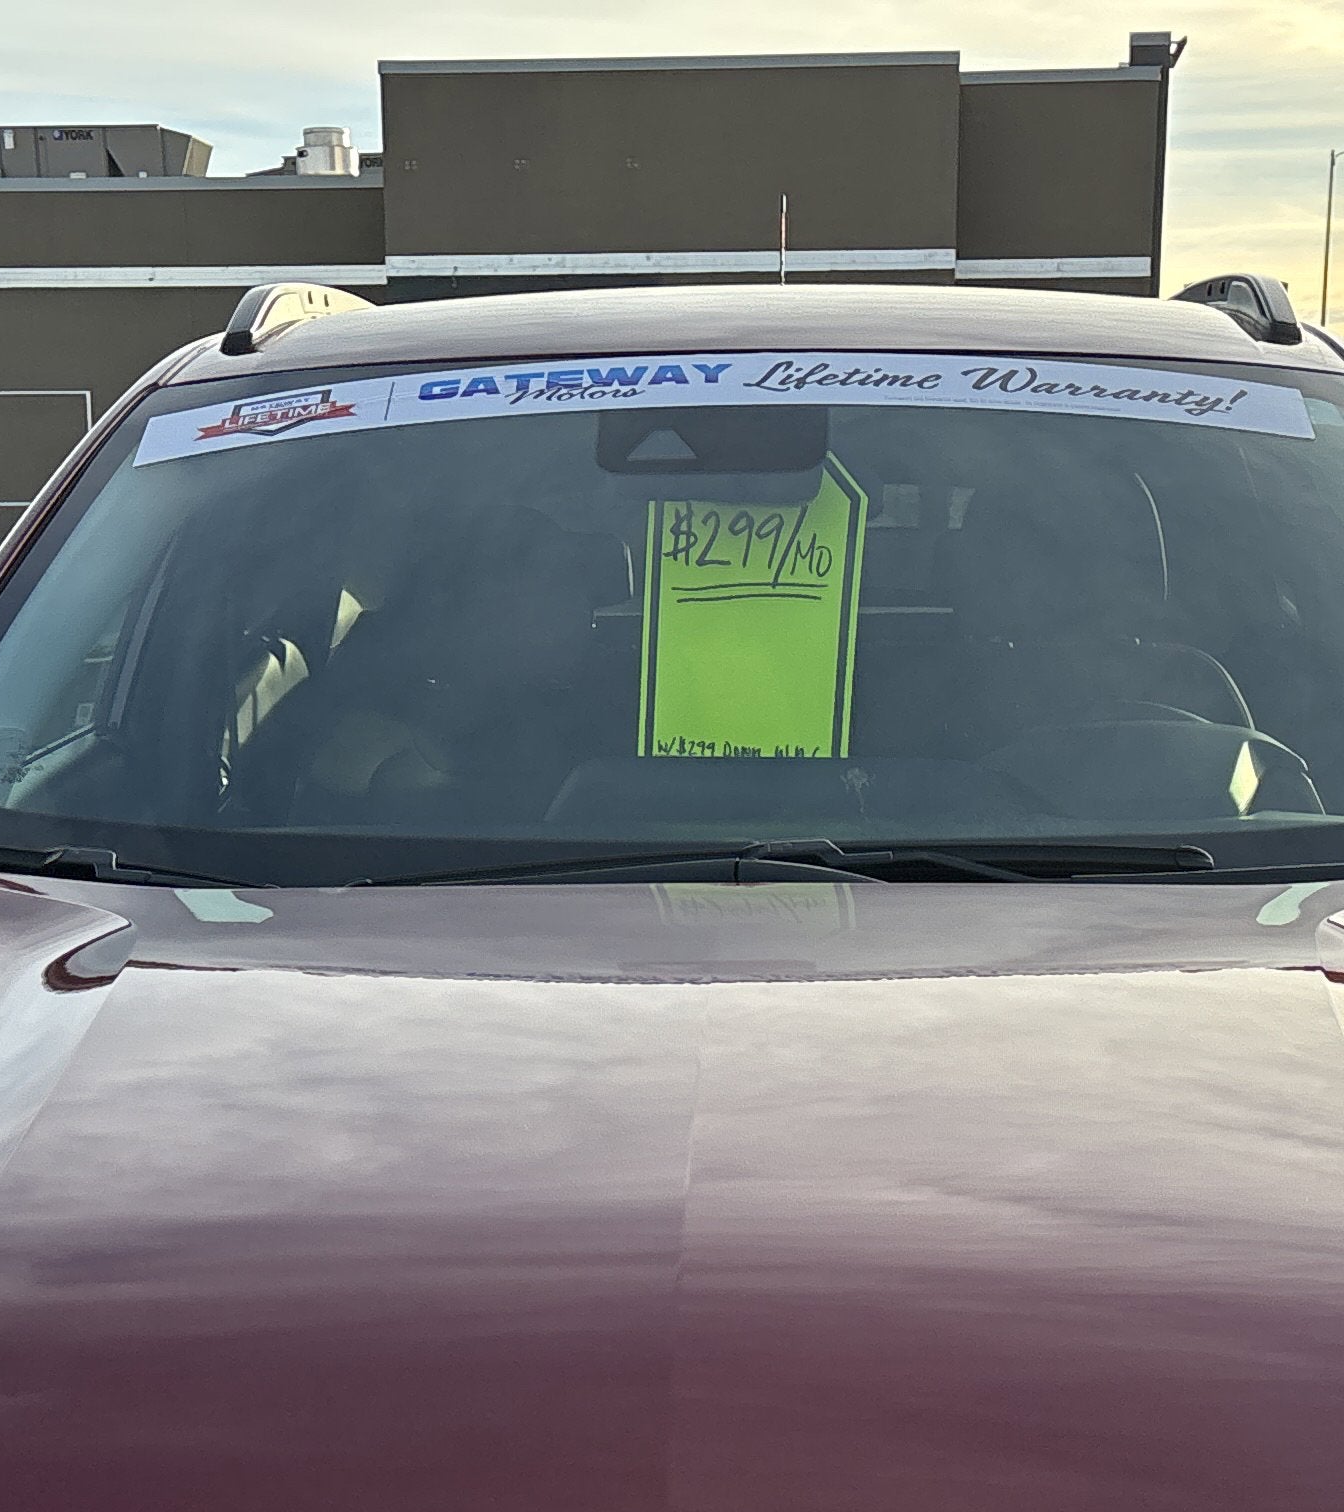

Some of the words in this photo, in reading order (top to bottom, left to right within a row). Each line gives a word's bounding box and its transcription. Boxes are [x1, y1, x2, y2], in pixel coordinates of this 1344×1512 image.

[64, 129, 94, 141] YORK
[418, 363, 733, 400] GATEWAY
[743, 360, 942, 391] Lifetime
[961, 367, 1248, 416] Warranty!
[504, 385, 646, 405] Motors
[224, 402, 331, 428] LIFETIME
